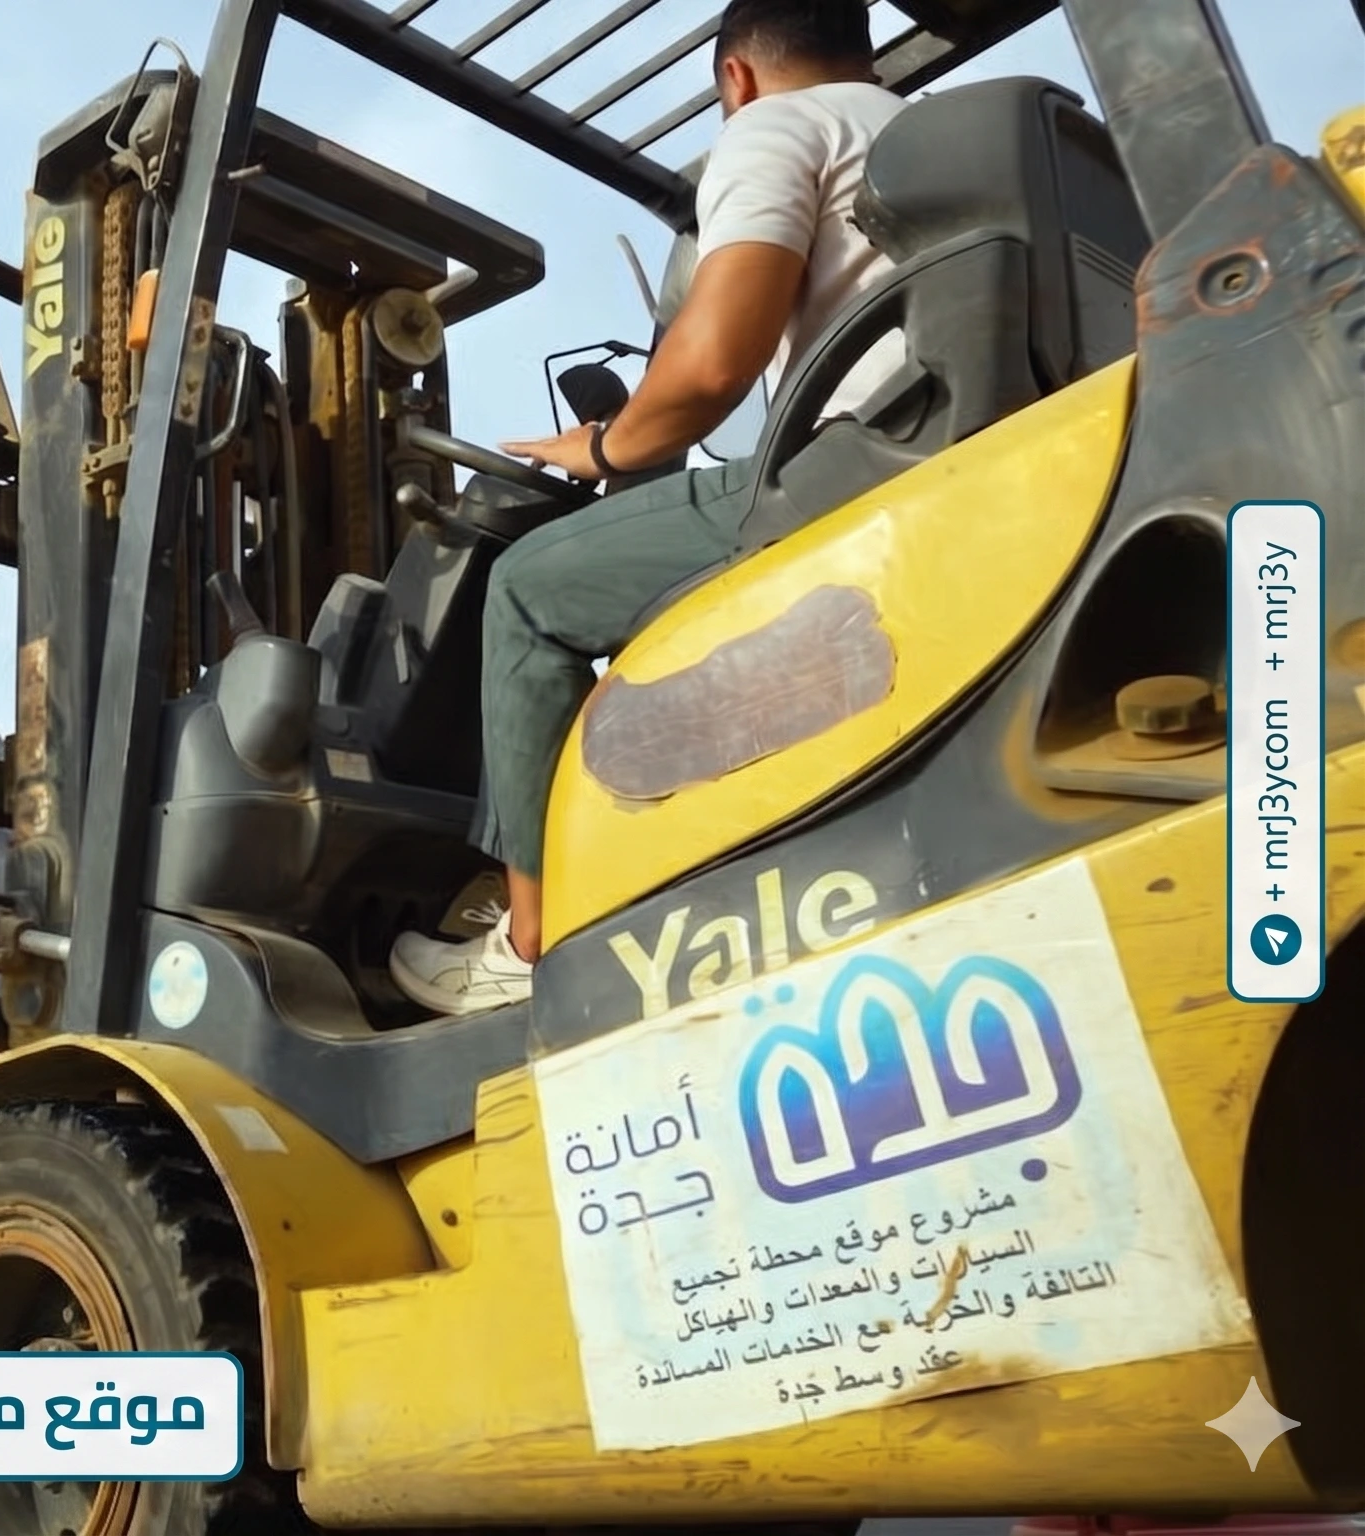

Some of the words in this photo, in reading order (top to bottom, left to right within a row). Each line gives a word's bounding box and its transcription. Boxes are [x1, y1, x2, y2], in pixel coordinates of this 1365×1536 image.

[26, 216, 66, 378] Yale
[607, 867, 878, 1020] Yale
[566, 1073, 700, 1174] أمانة
[579, 1171, 714, 1235] جدة
[911, 1188, 1017, 1245] مشروع
[749, 1245, 823, 1272] محطة
[835, 1220, 899, 1264] موقع
[910, 1229, 1035, 1280] السيارات
[673, 1259, 740, 1305] تجميع
[785, 1267, 901, 1310] والمعدات
[1024, 1260, 1117, 1300] التالفة
[676, 1298, 775, 1342] والهياكل
[857, 1320, 892, 1353] مع
[741, 1323, 843, 1364] الخدمات
[916, 1344, 964, 1376] عقد
[635, 1347, 731, 1388] المساندة
[834, 1365, 905, 1392] وسط
